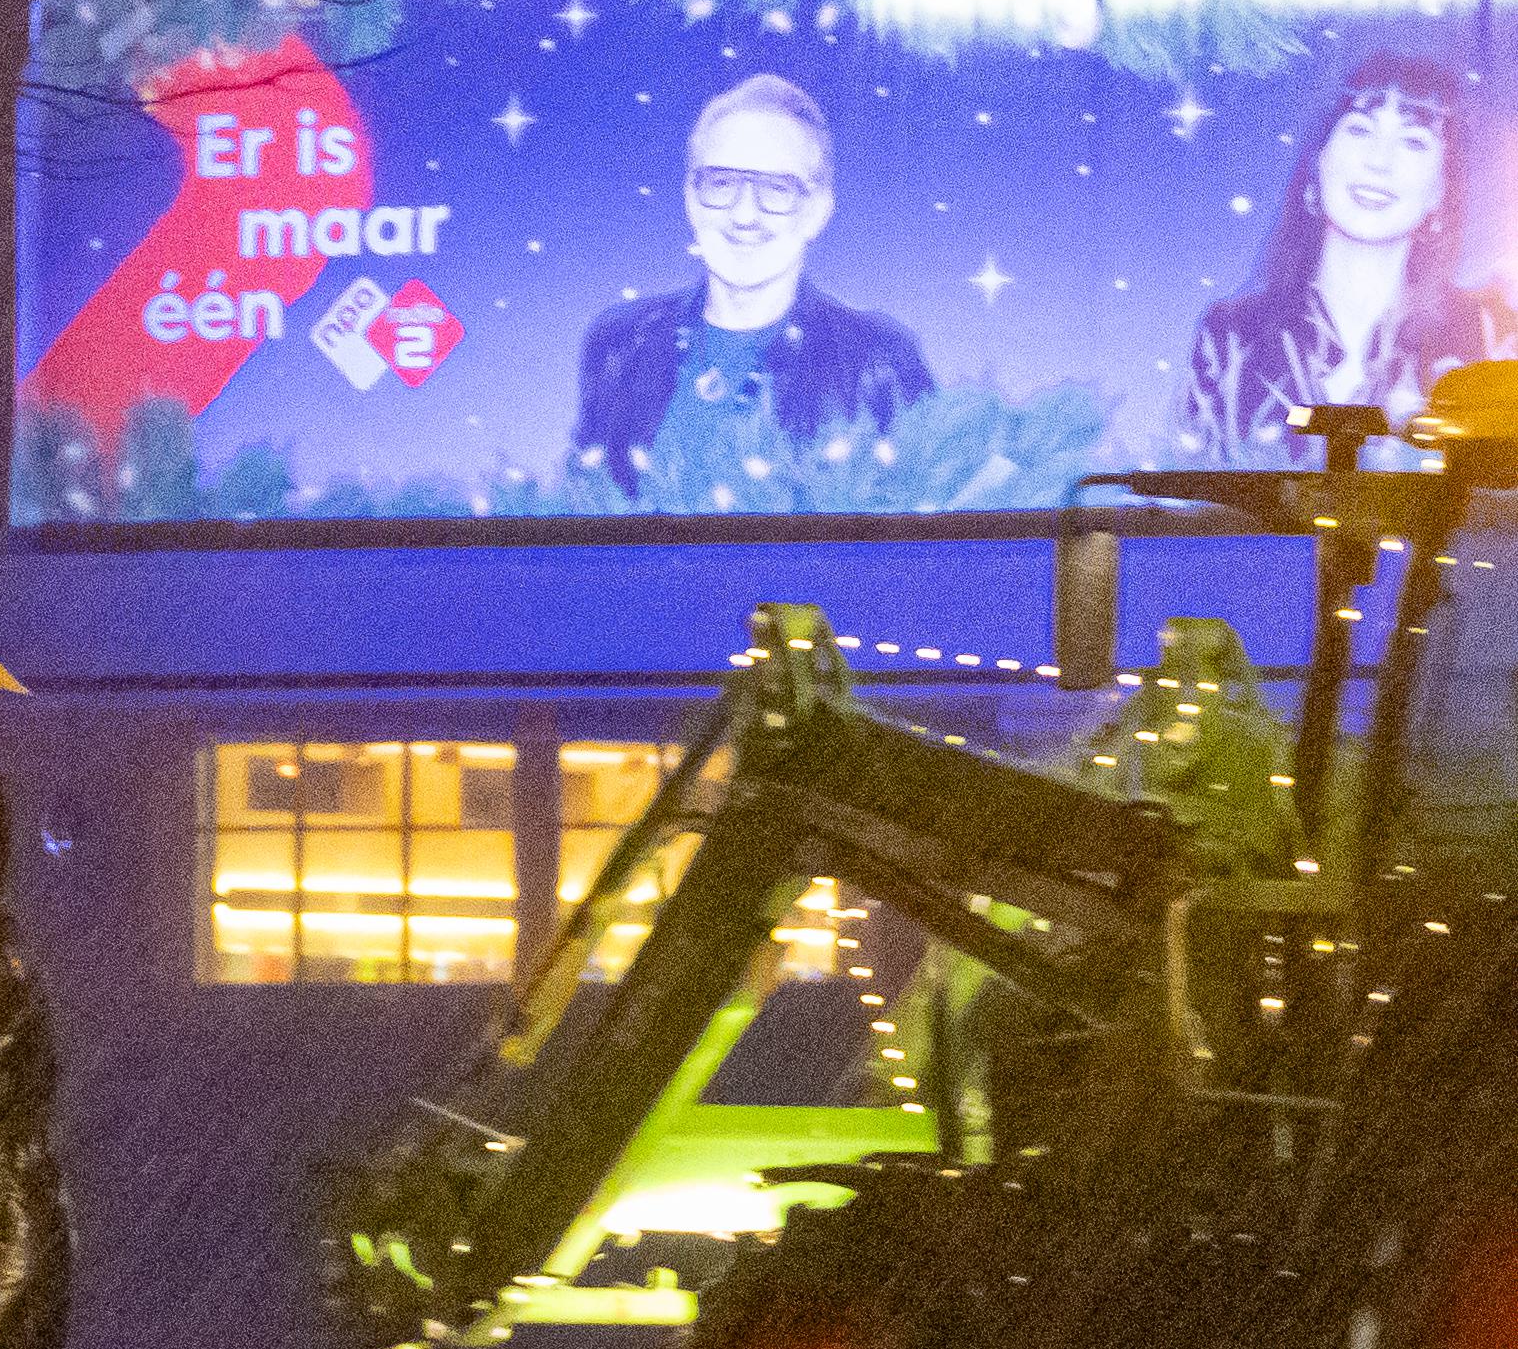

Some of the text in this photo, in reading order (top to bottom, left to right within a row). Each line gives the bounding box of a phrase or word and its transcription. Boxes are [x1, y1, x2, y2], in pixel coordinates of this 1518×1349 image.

[196, 109, 358, 179] Er is
[238, 205, 450, 258] maar
[142, 270, 286, 342] één
[320, 288, 376, 347] npo
[394, 325, 435, 369] 2
